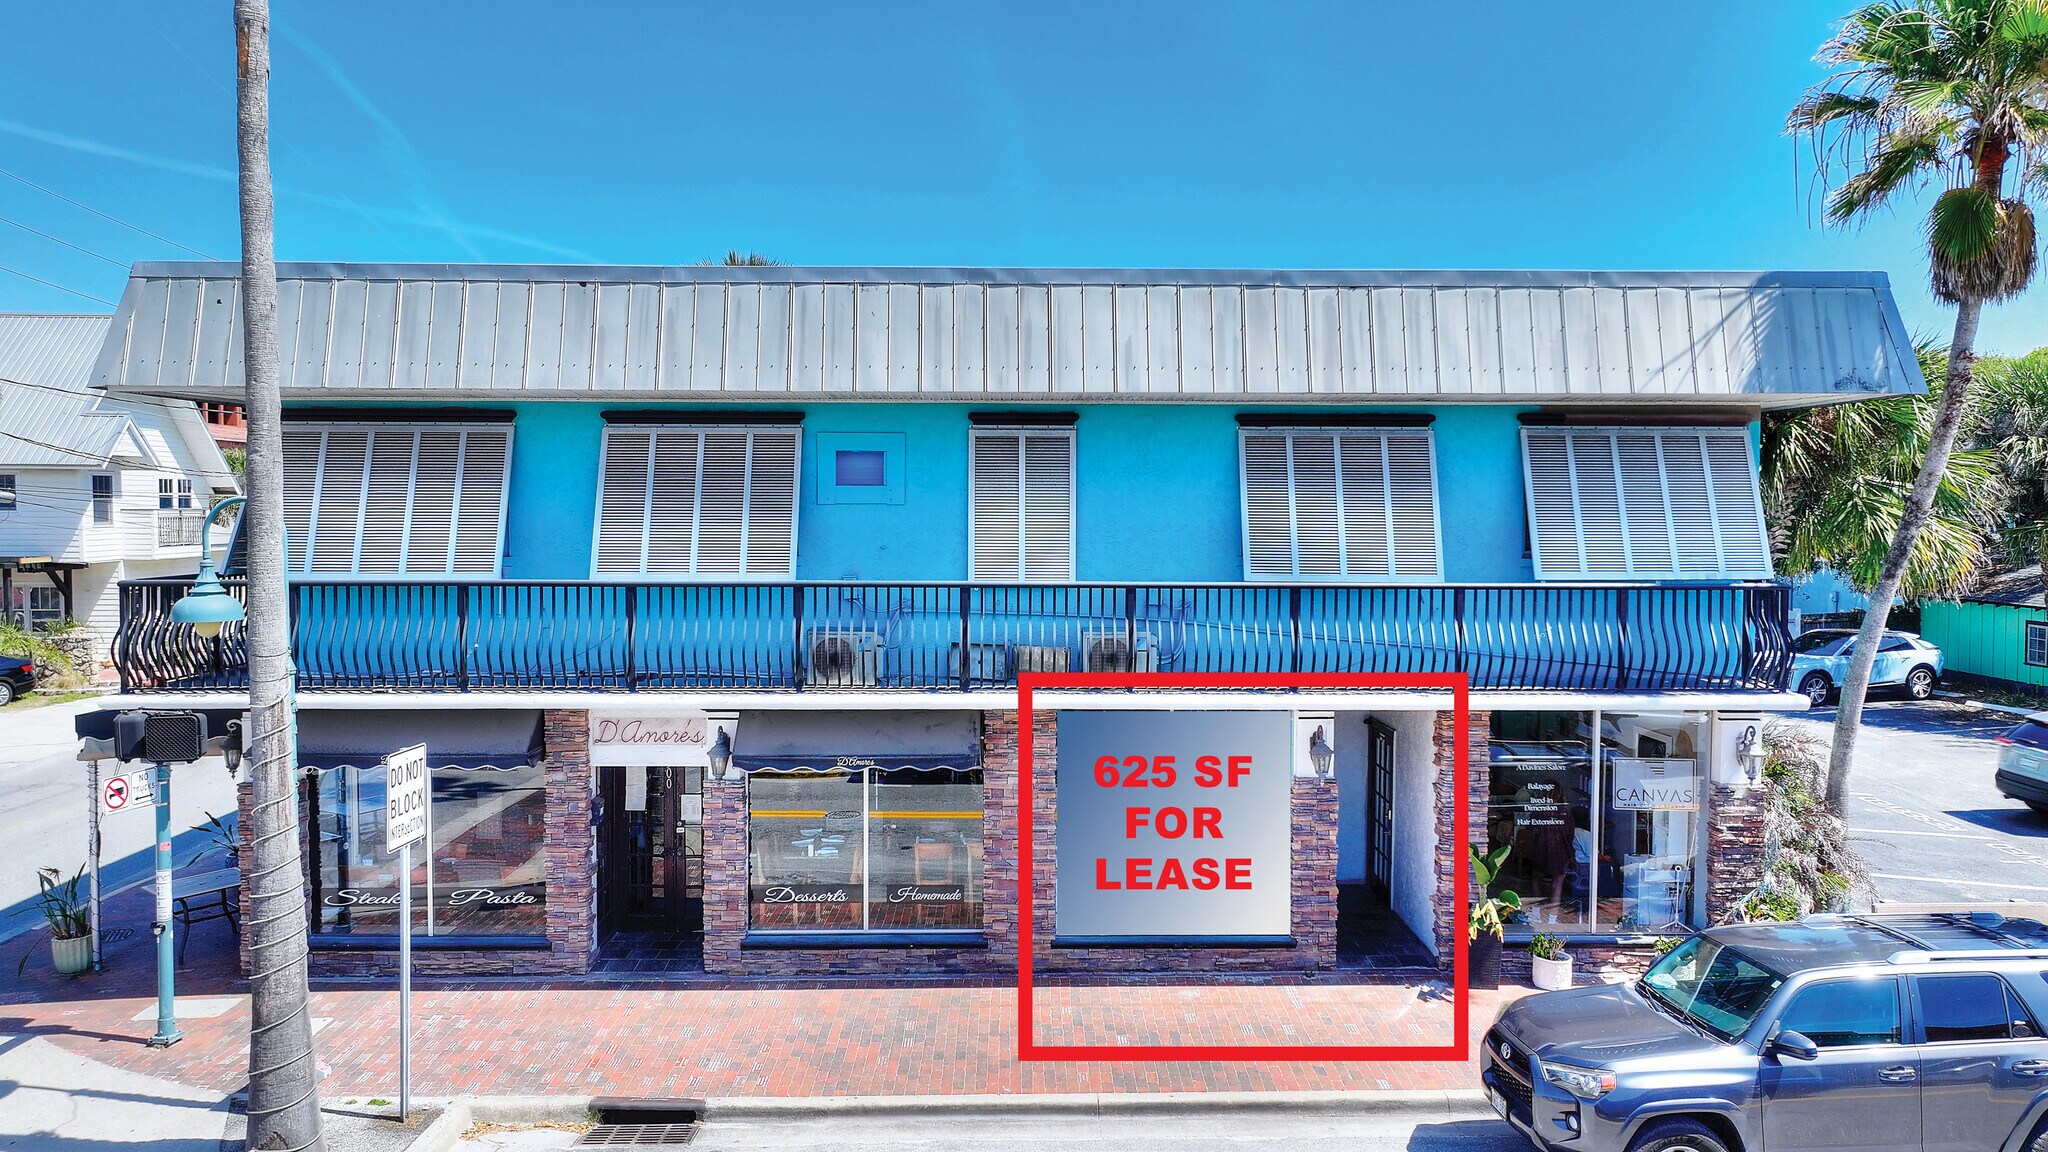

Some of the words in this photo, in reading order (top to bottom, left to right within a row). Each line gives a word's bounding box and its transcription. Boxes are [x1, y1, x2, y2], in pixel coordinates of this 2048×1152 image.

[138, 772, 148, 782] NO
[391, 766, 404, 788] DO
[406, 758, 424, 782] NOT
[133, 781, 155, 793] TRUCKS
[1616, 788, 1693, 803] CANVAS
[390, 787, 424, 820] BLOCK
[390, 815, 424, 841] INTERSECTION
[448, 888, 538, 906] Pasta
[763, 886, 849, 903] Desserts
[889, 886, 962, 903] Homemade
